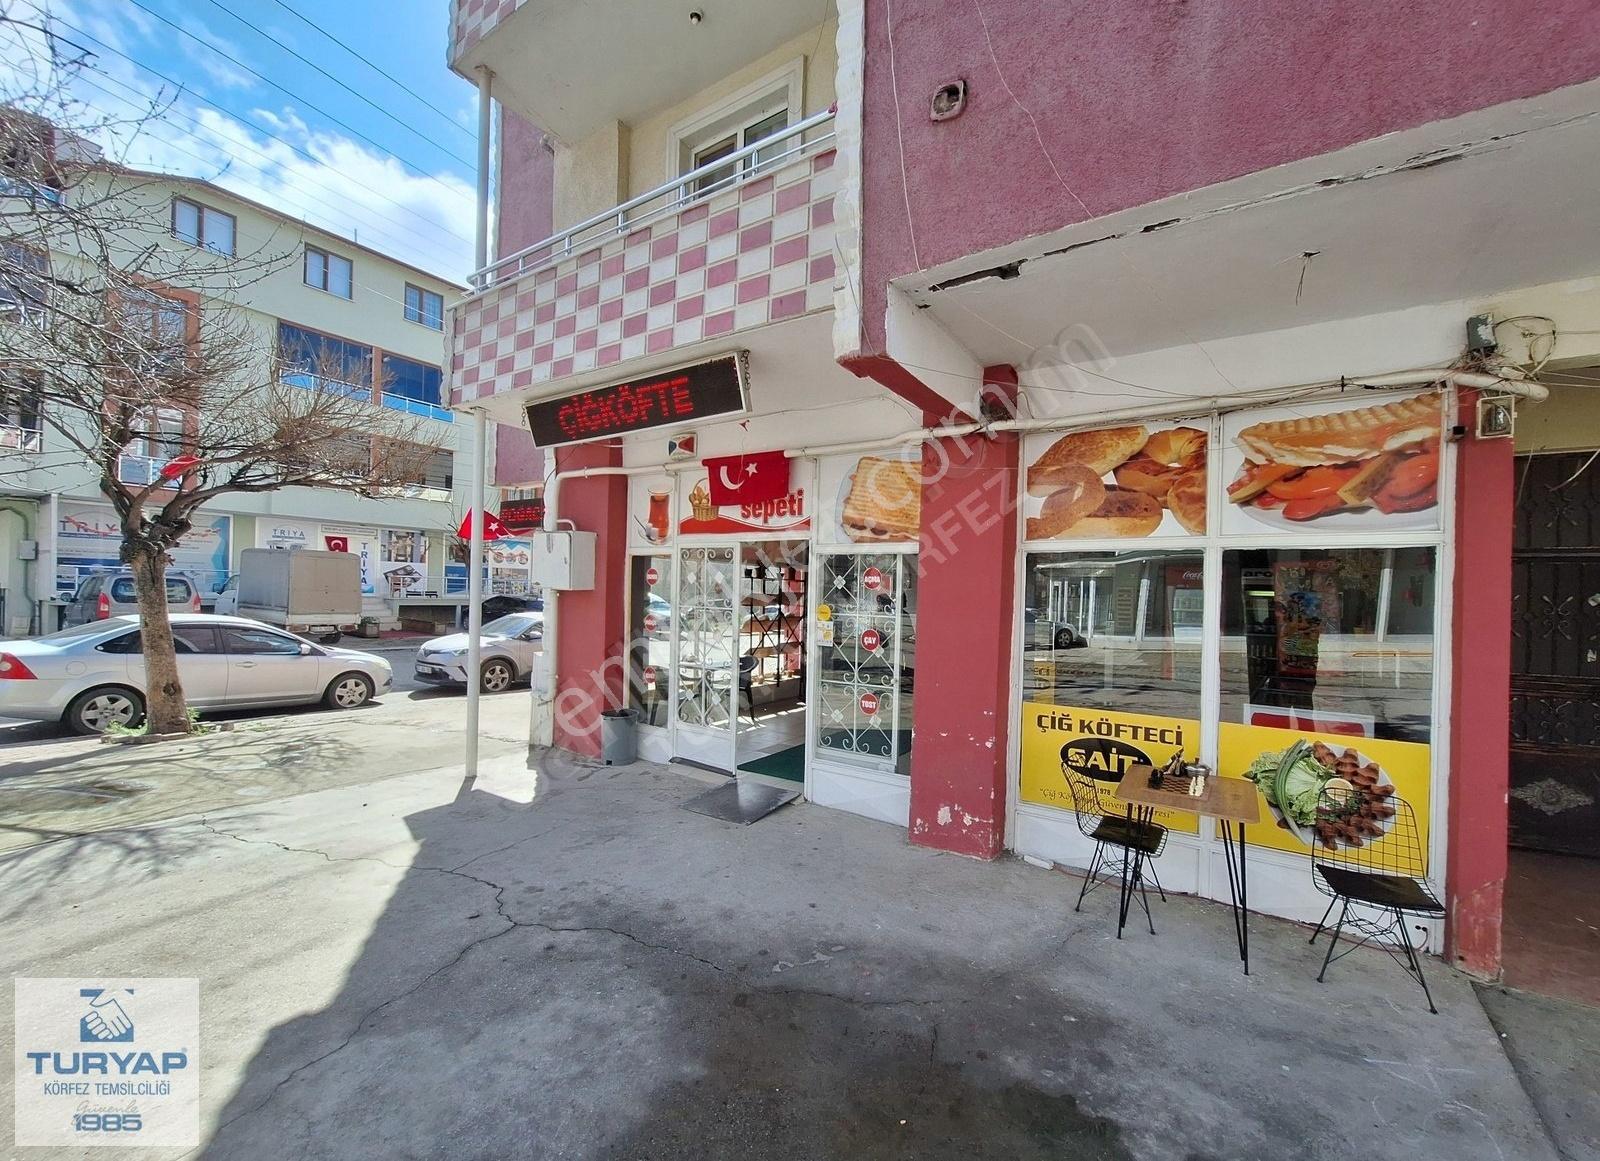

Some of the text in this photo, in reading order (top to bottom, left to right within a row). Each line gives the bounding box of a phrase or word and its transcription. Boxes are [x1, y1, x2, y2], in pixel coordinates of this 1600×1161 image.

[741, 488, 805, 524] sepeti
[863, 636, 877, 646] ÇAY
[861, 700, 877, 709] TOST
[1037, 711, 1184, 746] ÇİĞ KÖFTECİ
[1067, 747, 1139, 774] SAİT
